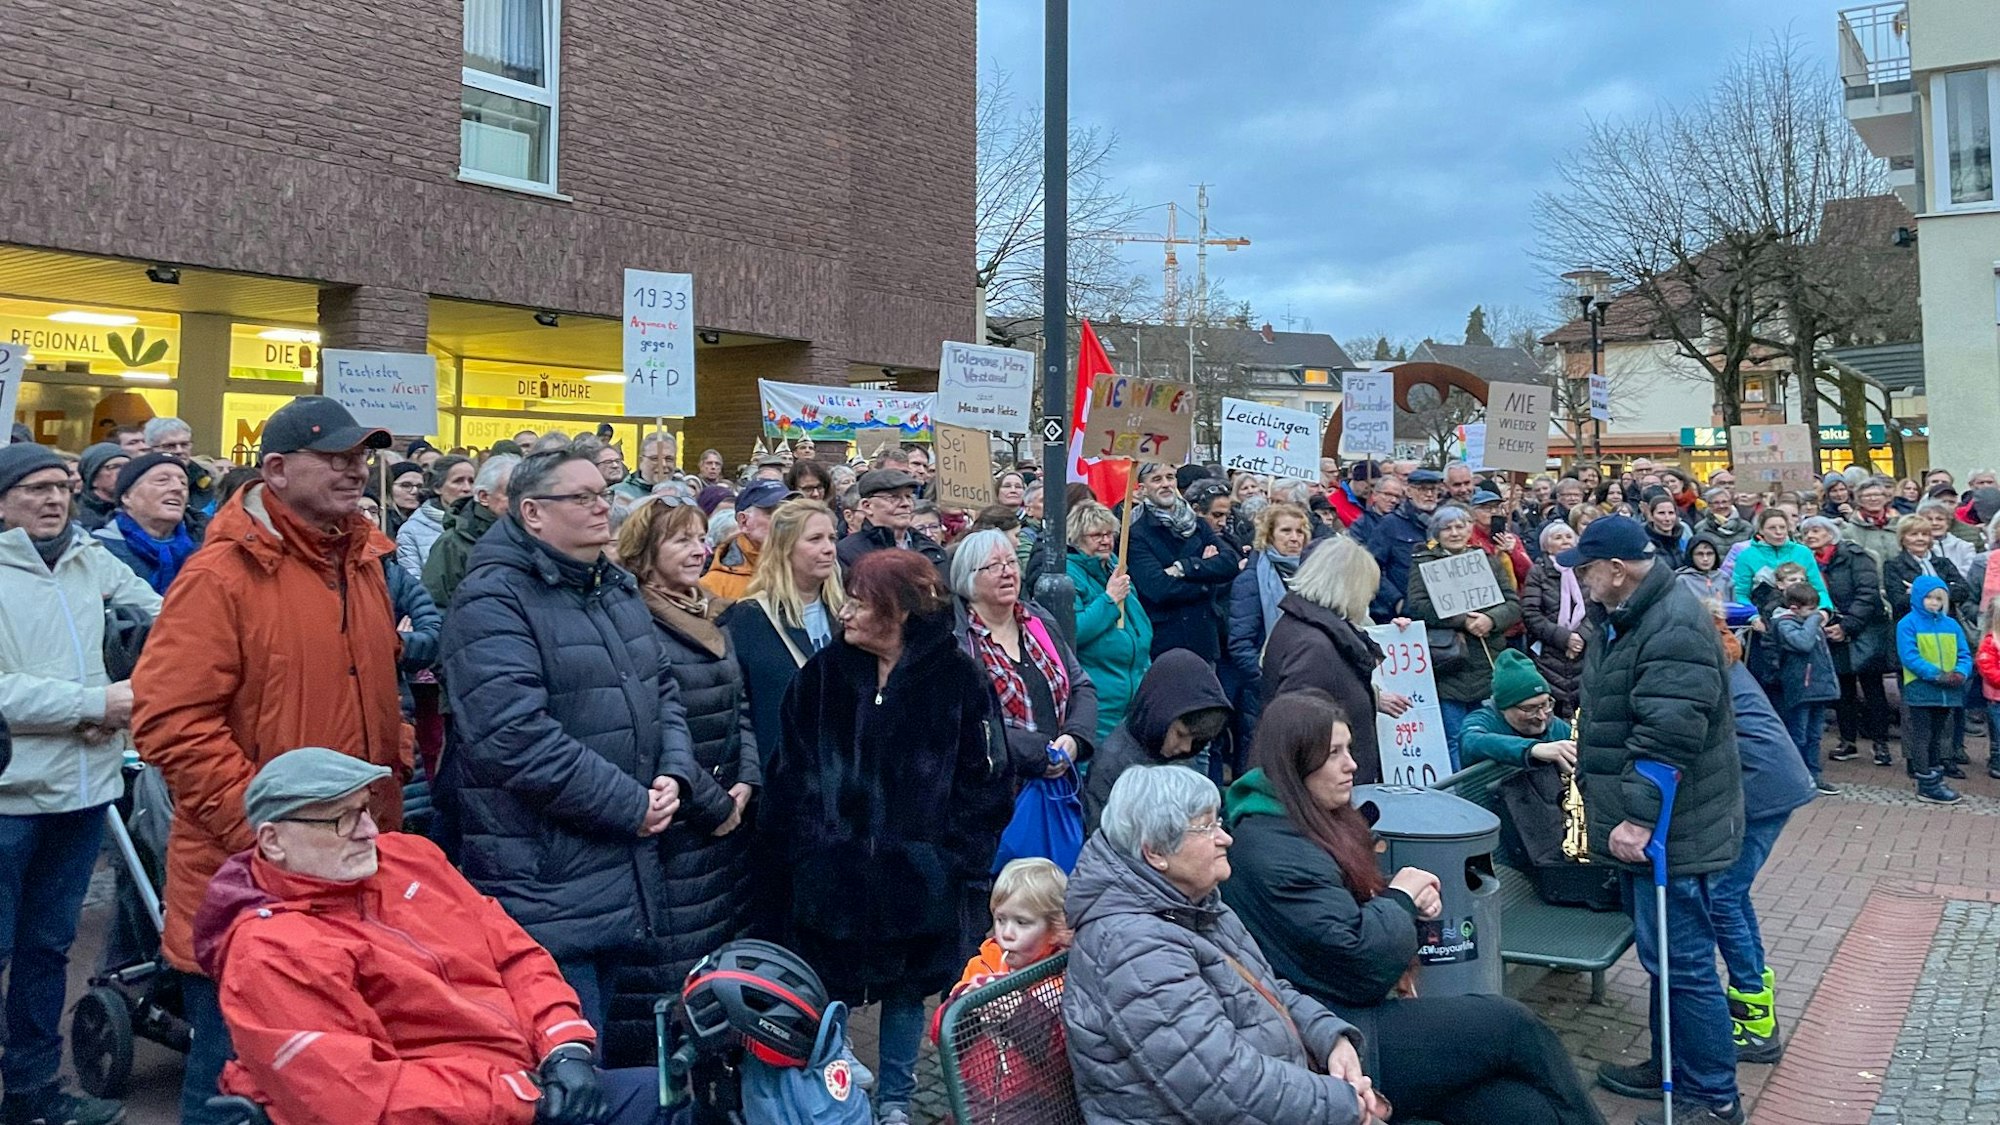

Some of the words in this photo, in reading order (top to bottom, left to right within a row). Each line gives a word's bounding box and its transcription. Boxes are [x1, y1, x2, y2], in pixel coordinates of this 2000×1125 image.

[633, 287, 687, 311] 1933
[630, 316, 678, 335] Argumente
[10, 328, 105, 354] REGIONAL.
[640, 340, 674, 353] gegen
[266, 343, 294, 364] DIE
[645, 355, 667, 368] die
[338, 361, 402, 380] Faschisten
[963, 367, 1008, 384] Verstand
[391, 381, 429, 395] NICHT
[518, 380, 537, 395] DIE
[552, 380, 592, 399] MÖHRE
[630, 368, 680, 397] AfD
[1347, 378, 1376, 391] Für
[818, 394, 862, 407] Vielfalt
[1093, 378, 1127, 410] NIE
[1131, 381, 1194, 415] WIEDER
[1503, 391, 1537, 415] NIE
[957, 401, 979, 414] Hass
[981, 406, 995, 414] und
[467, 422, 501, 438] OBST
[1226, 404, 1310, 436] Leichlingen
[1346, 416, 1389, 438] Gegen
[1499, 418, 1537, 432] WIEDER
[940, 429, 967, 454] Sei
[1101, 429, 1169, 456] JETZT
[1256, 430, 1291, 452] Bunt
[1498, 437, 1535, 454] RECHTS
[943, 454, 967, 473] ein
[1227, 454, 1269, 473] statt
[1270, 455, 1315, 481] Braun
[941, 478, 990, 503] Mensch
[1443, 553, 1487, 579] WIEDER
[1437, 592, 1456, 612] IST
[1461, 585, 1498, 610] JETZT
[1402, 743, 1422, 757] die
